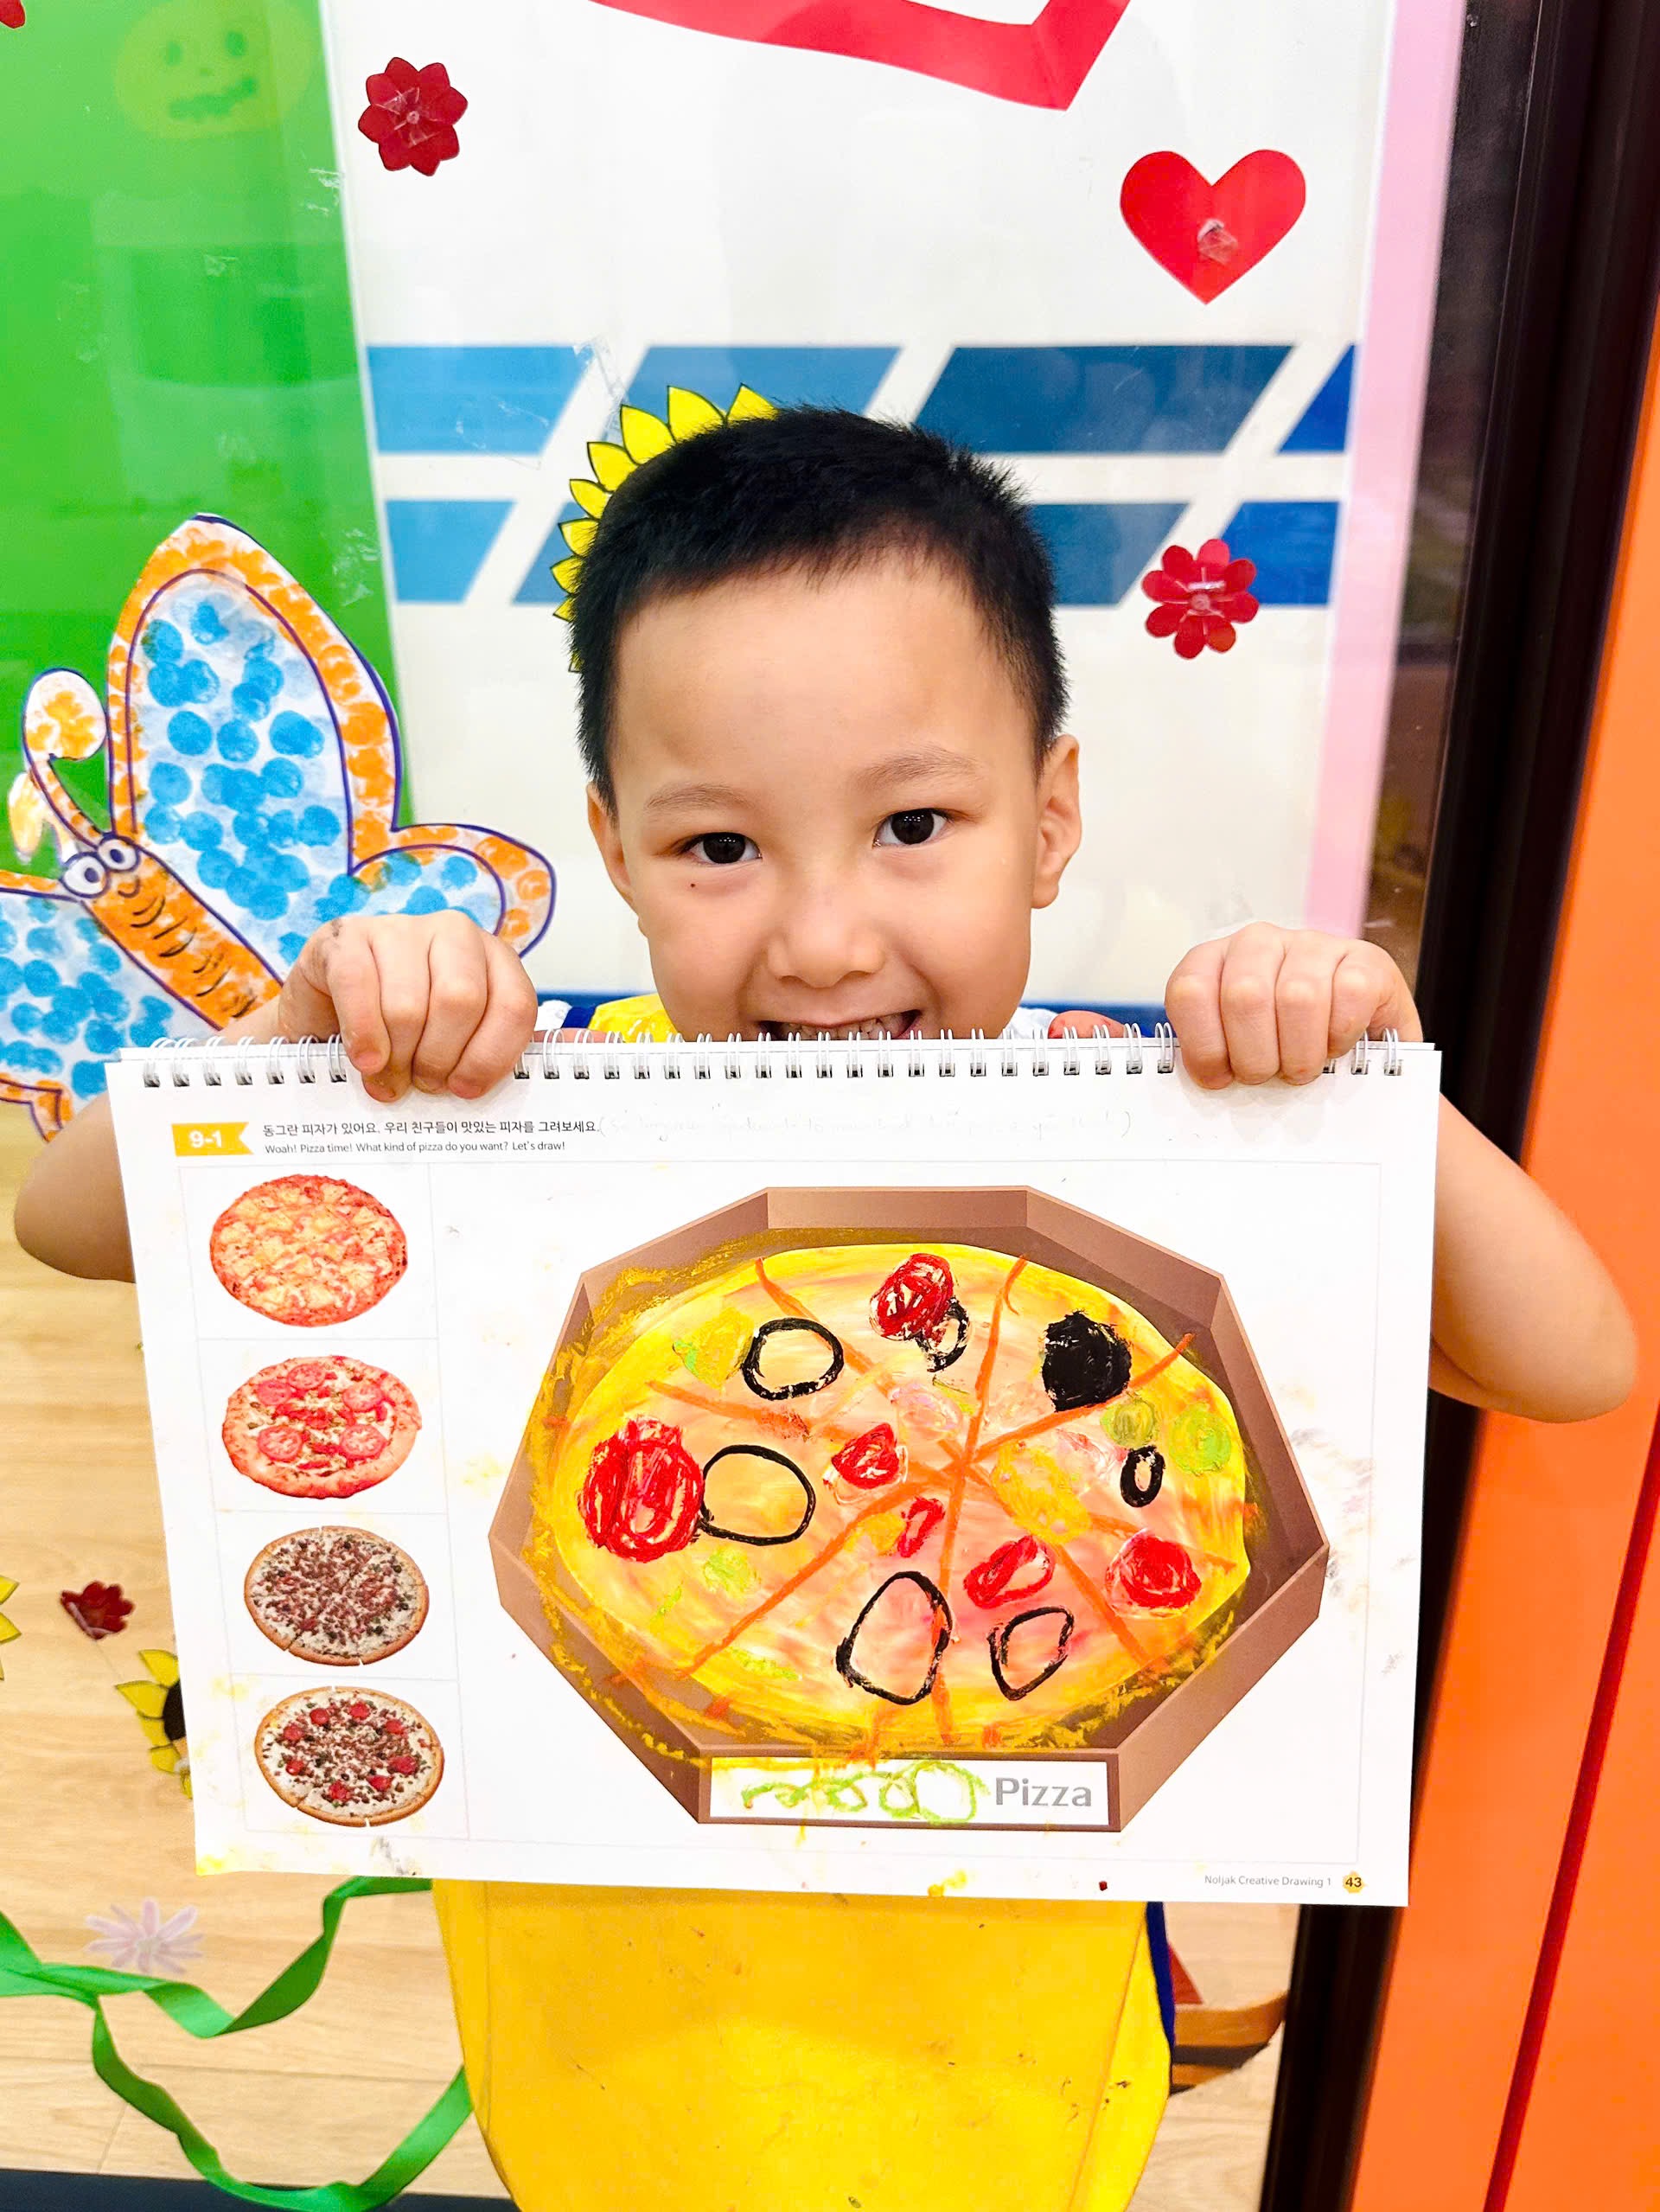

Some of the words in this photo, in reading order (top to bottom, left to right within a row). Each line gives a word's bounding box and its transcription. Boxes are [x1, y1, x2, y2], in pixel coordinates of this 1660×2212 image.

[263, 1123, 298, 1137] 동그란
[302, 1122, 338, 1135] 피자가
[384, 1122, 408, 1135] 우리
[412, 1121, 458, 1135] 친구들이
[461, 1121, 497, 1134] 맛있는
[500, 1121, 535, 1134] 피자를
[188, 1128, 222, 1149] 9-1
[265, 1144, 297, 1154] Woah!
[300, 1144, 325, 1154] Pizza
[327, 1143, 353, 1153] time!
[355, 1142, 382, 1152] What
[384, 1141, 405, 1152] kind
[406, 1141, 417, 1152] of
[418, 1141, 444, 1154] pizza
[444, 1141, 458, 1151] do
[459, 1142, 478, 1154] you
[479, 1141, 508, 1151] want?
[512, 1141, 536, 1151] Let's
[537, 1141, 565, 1151] draw!
[995, 1777, 1092, 1807] Pizza
[1204, 1875, 1237, 1887] Noljak
[1238, 1875, 1280, 1886] Creative
[1281, 1876, 1324, 1889] Drawing
[1345, 1876, 1363, 1888] 43
